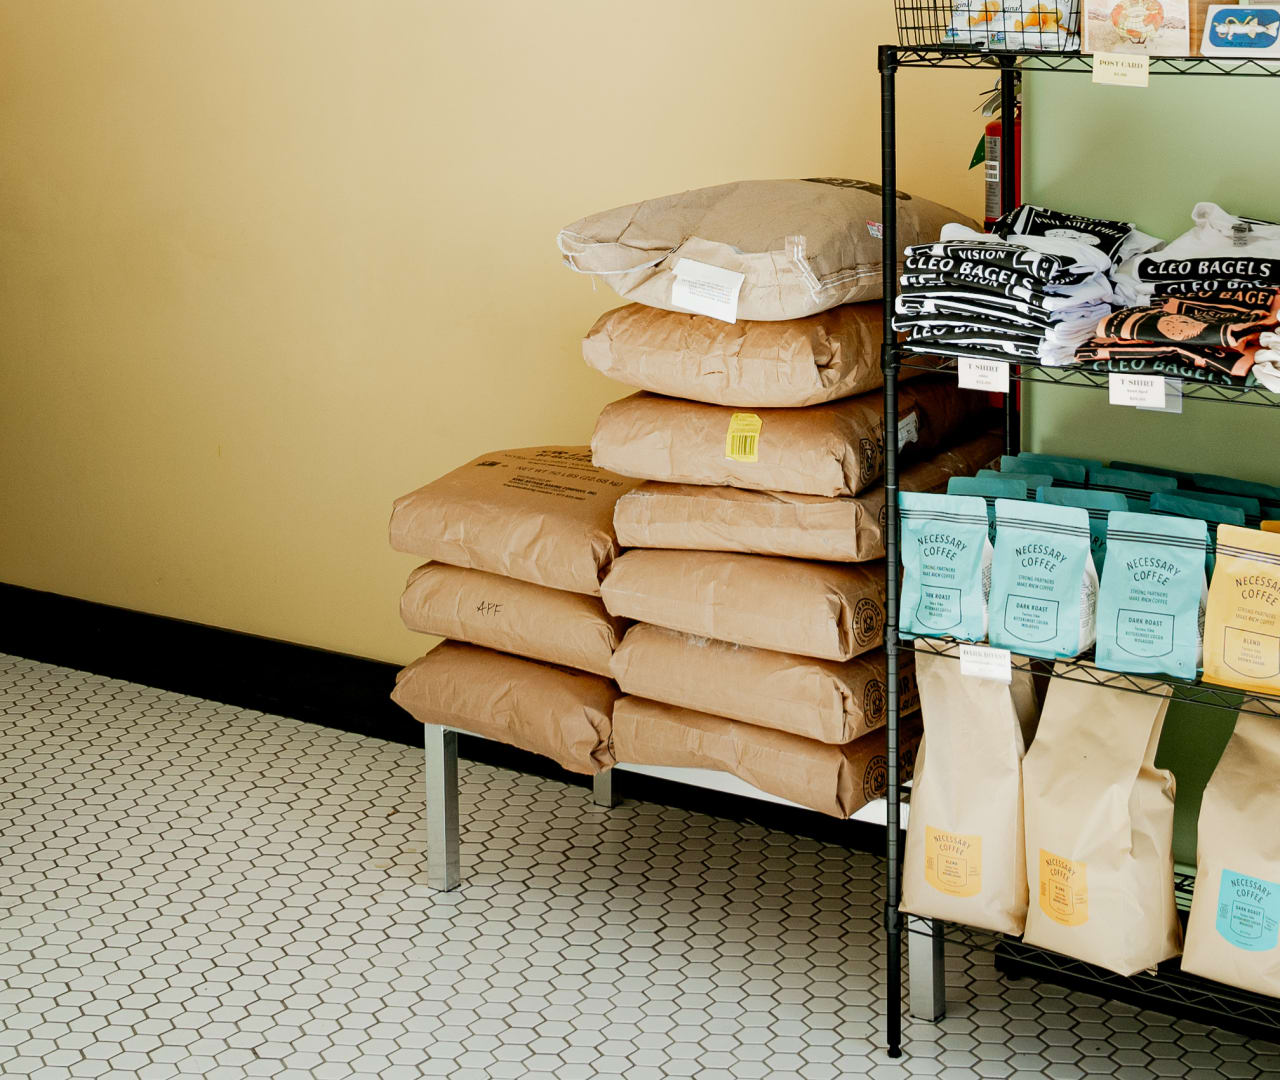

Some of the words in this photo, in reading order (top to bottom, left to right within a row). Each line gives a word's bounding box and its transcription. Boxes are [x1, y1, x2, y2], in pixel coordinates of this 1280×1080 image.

[1099, 59, 1119, 68] POST
[958, 250, 1006, 260] VISION
[906, 256, 954, 271] CLEO
[960, 262, 1034, 290] BAGELS
[1147, 261, 1190, 275] CLEO
[1198, 260, 1272, 277] BAGELS
[1015, 544, 1068, 564] NECESSARY
[1021, 557, 1057, 573] COFFEE
[1126, 557, 1181, 576] NECESSARY
[1133, 571, 1170, 587] COFFEE
[1241, 589, 1279, 607] COFFEE
[1016, 602, 1031, 611] DARK
[1033, 604, 1049, 613] ROAST
